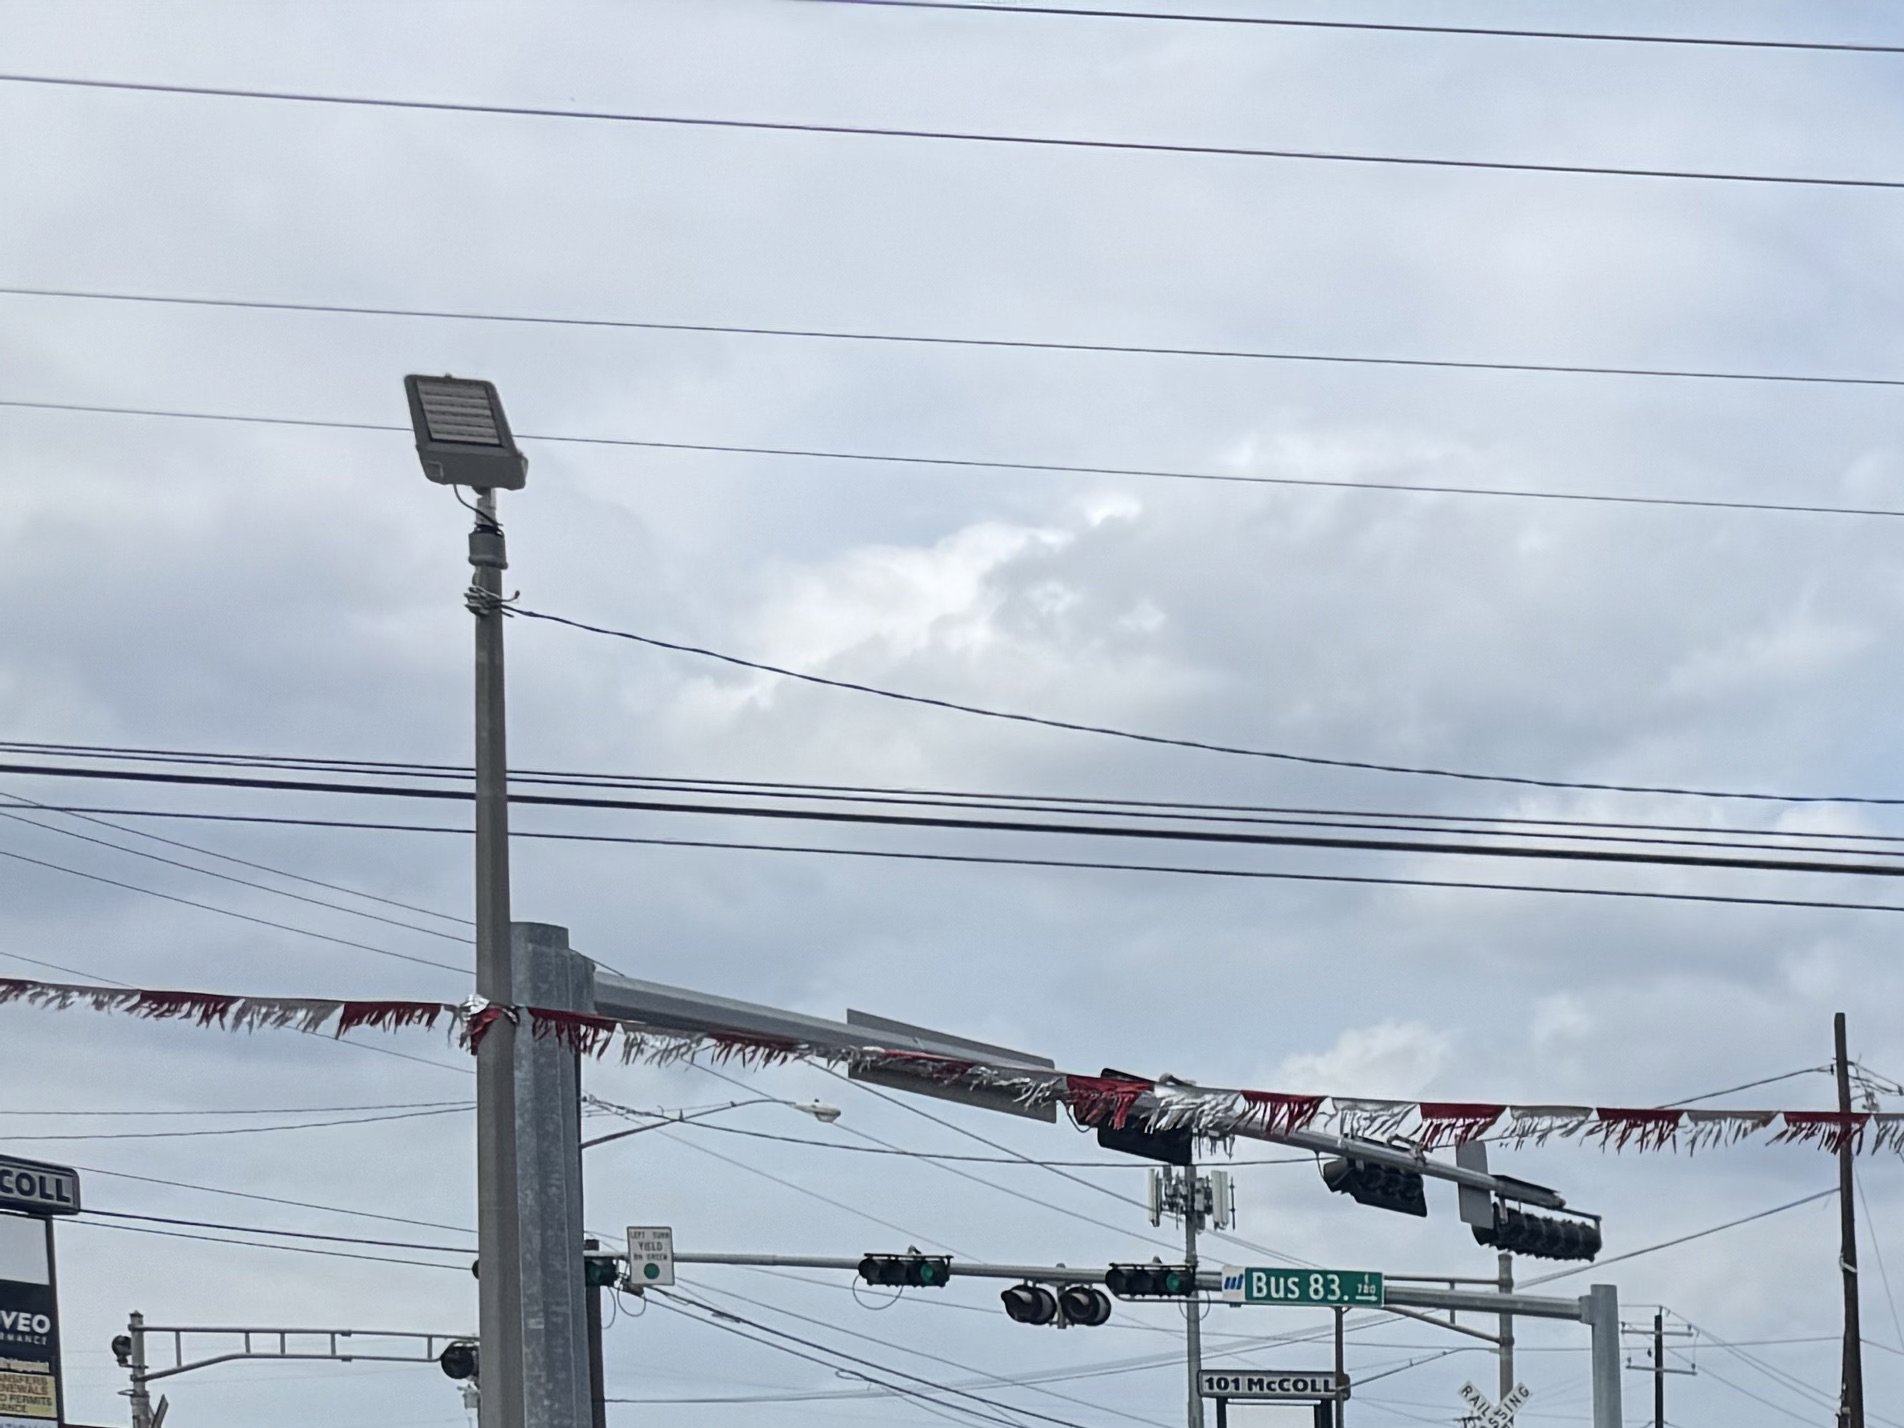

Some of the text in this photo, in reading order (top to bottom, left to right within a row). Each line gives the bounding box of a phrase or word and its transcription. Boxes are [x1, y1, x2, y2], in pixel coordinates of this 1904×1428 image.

[638, 1241, 663, 1251] YIELD
[1252, 1272, 1300, 1299] Bus
[1205, 1377, 1336, 1393] 101 McCOLL
